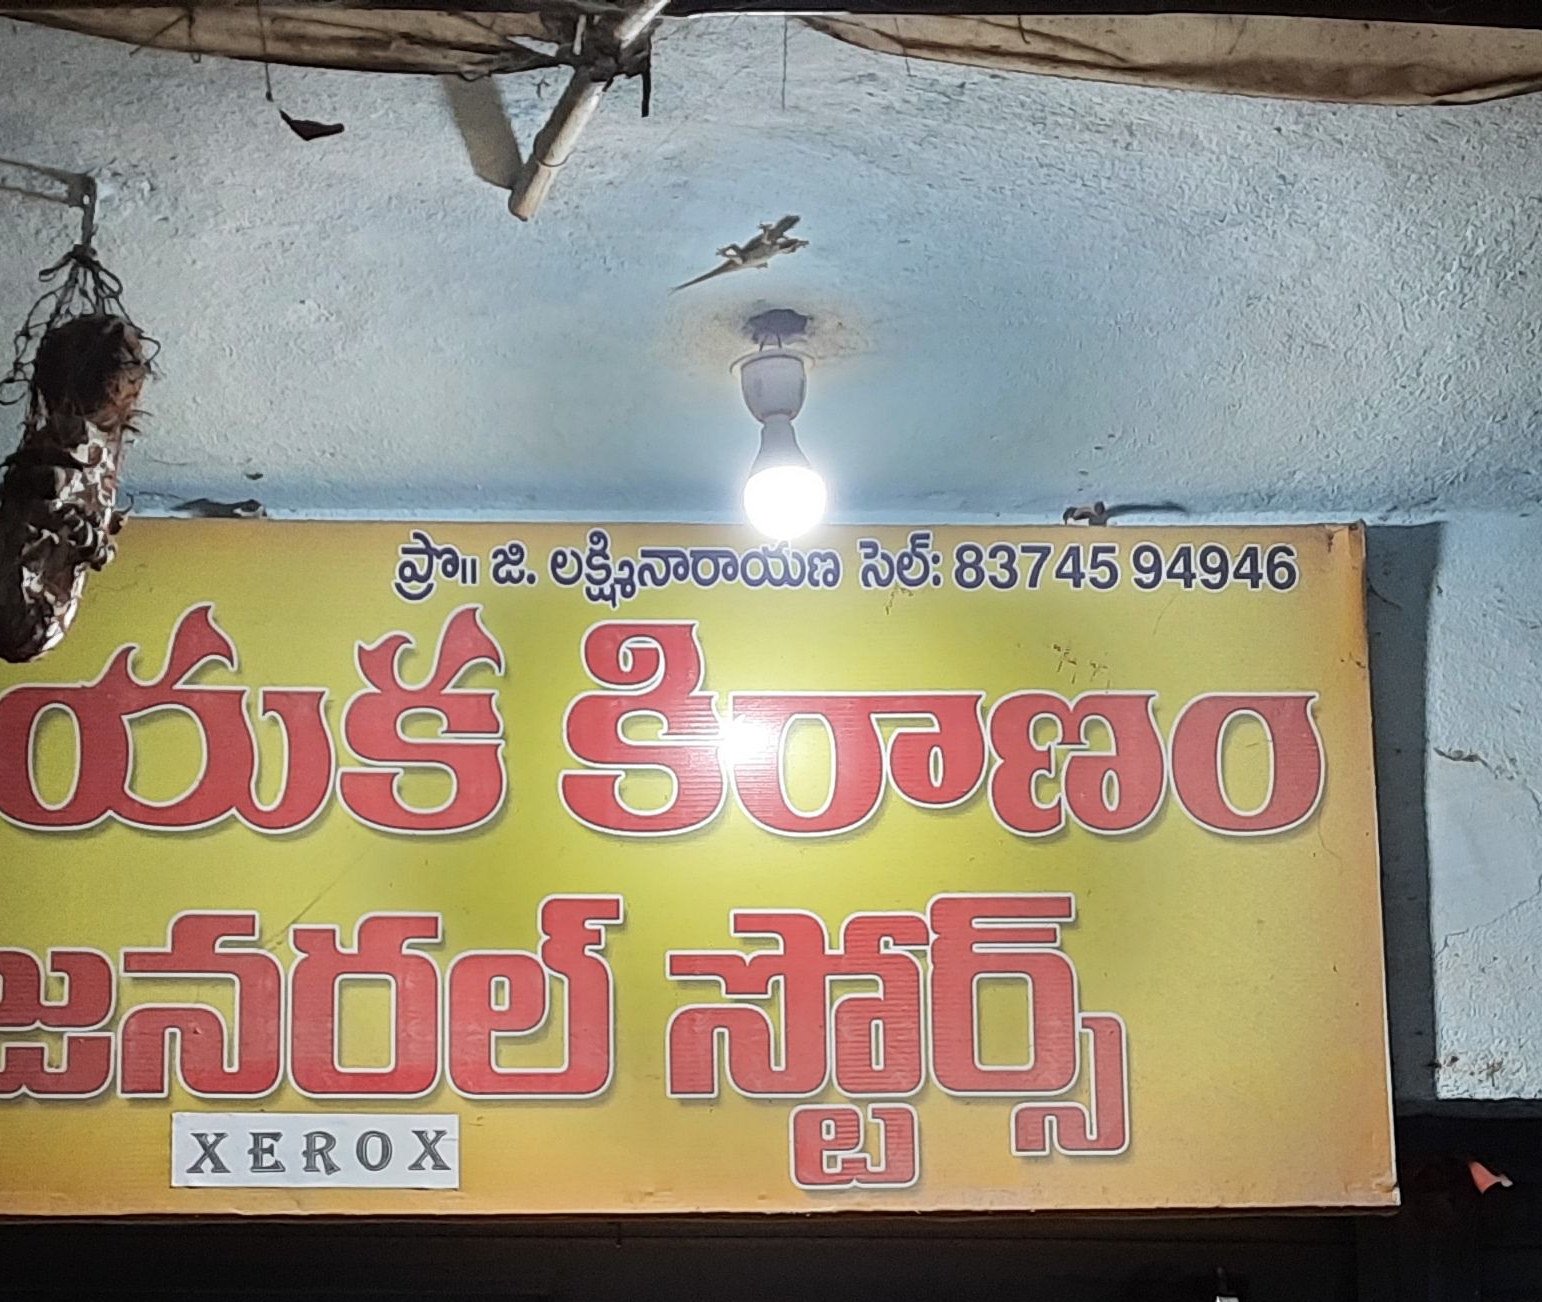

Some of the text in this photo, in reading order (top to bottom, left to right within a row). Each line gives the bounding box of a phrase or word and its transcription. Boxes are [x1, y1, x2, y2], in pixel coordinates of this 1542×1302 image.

[955, 545, 1119, 590] 83745
[1132, 545, 1297, 590] 94946
[561, 620, 1322, 835] కిరాణం
[667, 893, 1128, 1188] స్టోర్స్
[186, 1130, 451, 1175] XEROX
